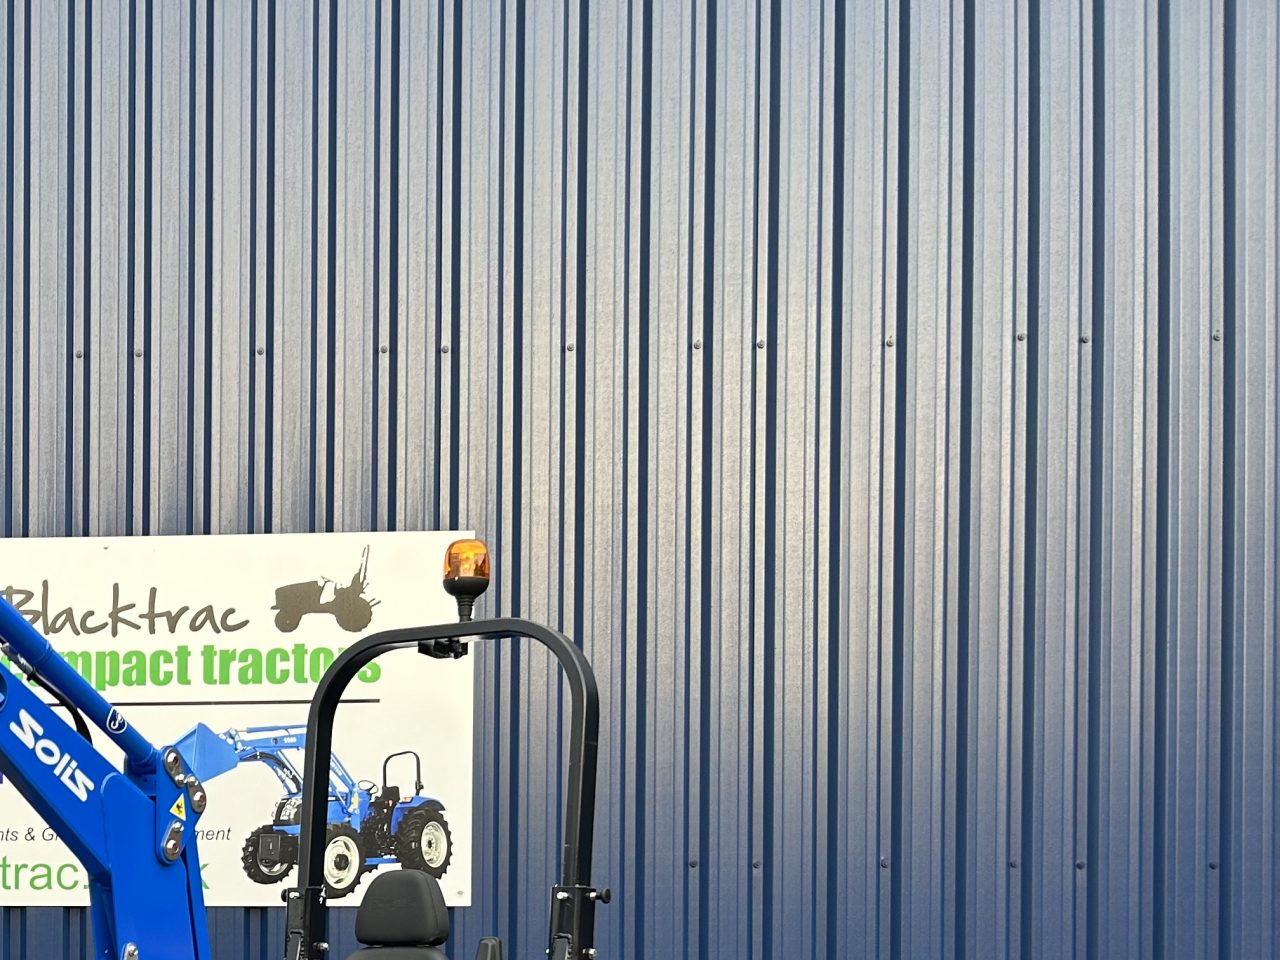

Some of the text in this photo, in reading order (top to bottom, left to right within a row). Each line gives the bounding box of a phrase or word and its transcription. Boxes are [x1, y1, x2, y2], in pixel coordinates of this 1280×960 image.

[0, 579, 250, 638] Blacktrac
[201, 643, 382, 685] tractos
[24, 827, 36, 841] &
